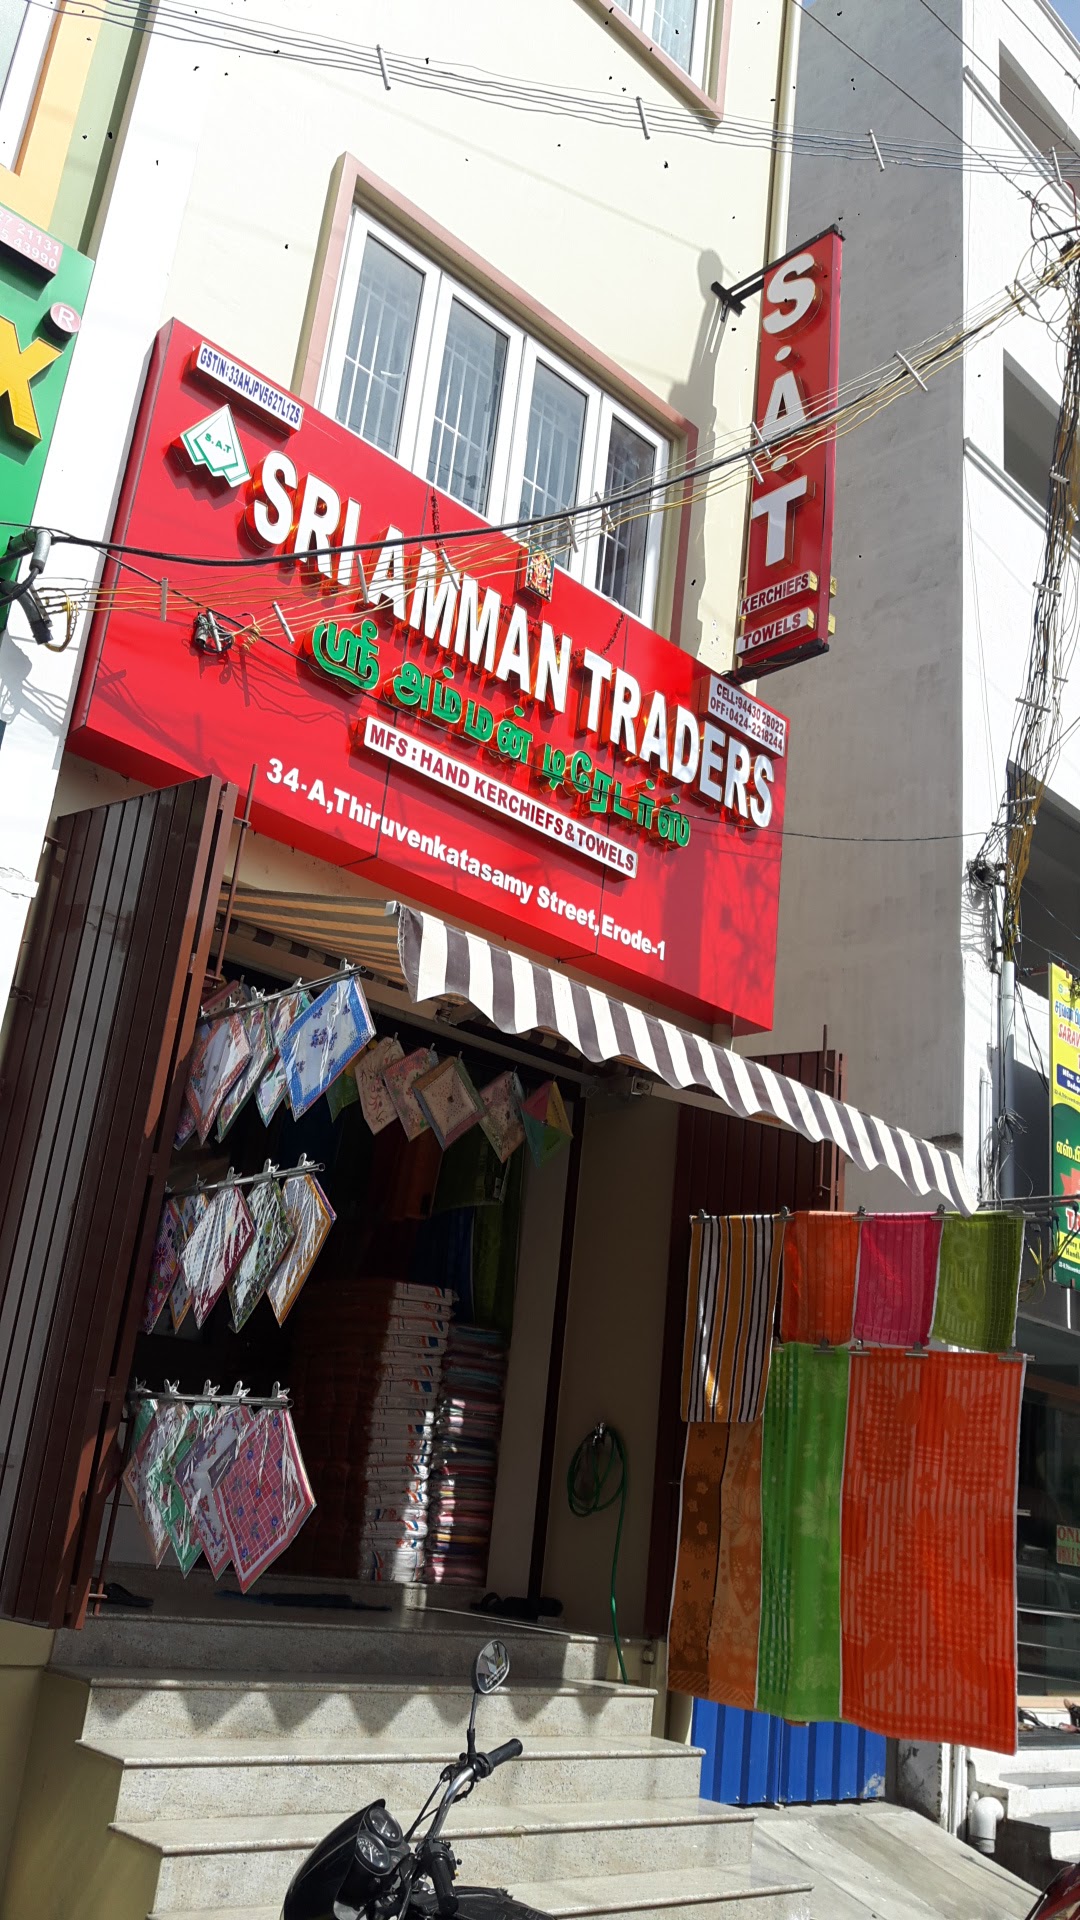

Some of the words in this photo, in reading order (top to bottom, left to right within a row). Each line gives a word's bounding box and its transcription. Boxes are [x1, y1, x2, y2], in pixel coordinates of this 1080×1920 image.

[14, 237, 57, 269] 43990
[17, 222, 59, 257] 21131
[741, 573, 809, 615] KERCHIEFS
[253, 450, 361, 586] SRI
[368, 524, 573, 714] AMMAN
[583, 647, 775, 828] TRADERS
[743, 613, 801, 649] TOWELS
[393, 661, 534, 764] அம்மன்
[761, 711, 784, 736] 28022
